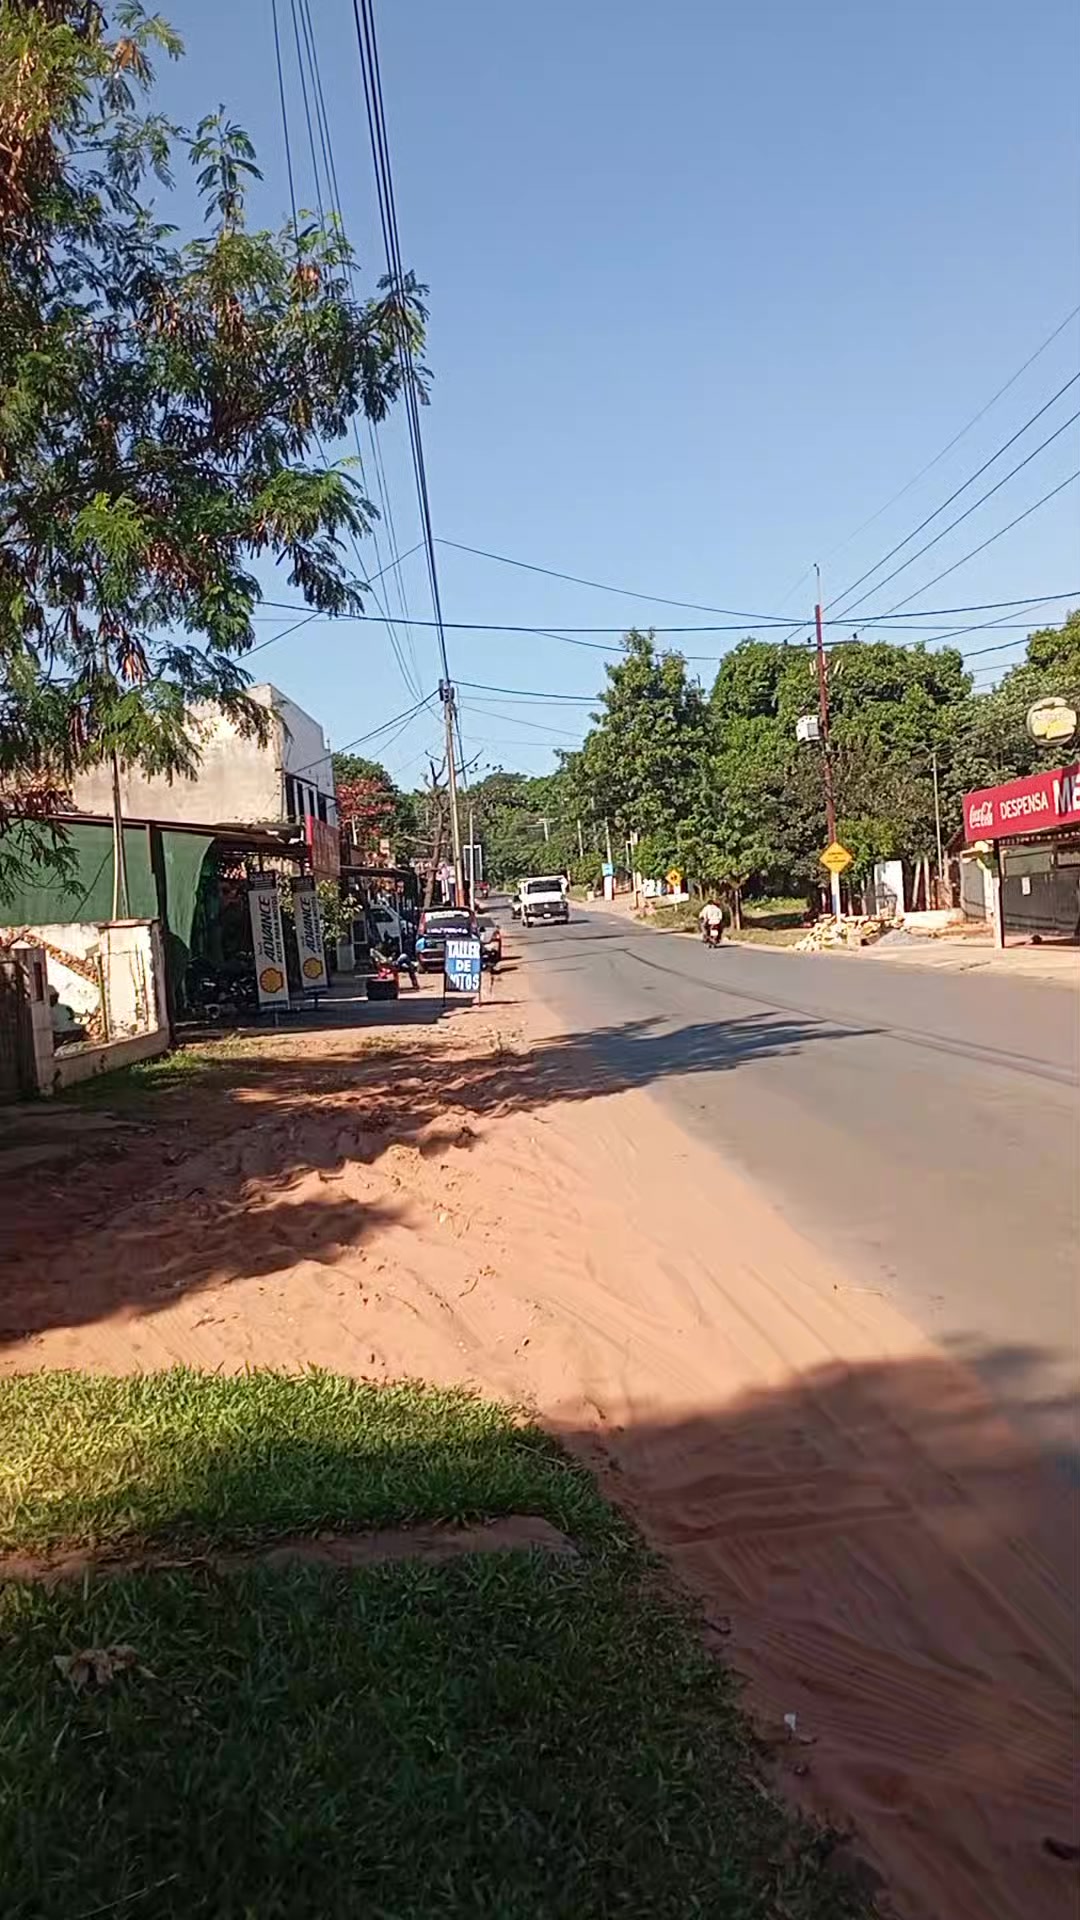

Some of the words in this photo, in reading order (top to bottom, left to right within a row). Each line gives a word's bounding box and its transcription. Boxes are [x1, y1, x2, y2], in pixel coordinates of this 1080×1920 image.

[1000, 791, 1049, 820] DESPENSA
[271, 895, 279, 920] MOTOS
[258, 895, 276, 963] ADVANCE
[300, 896, 316, 953] ADVANCE
[447, 941, 480, 959] TALLER
[455, 959, 471, 972] DE
